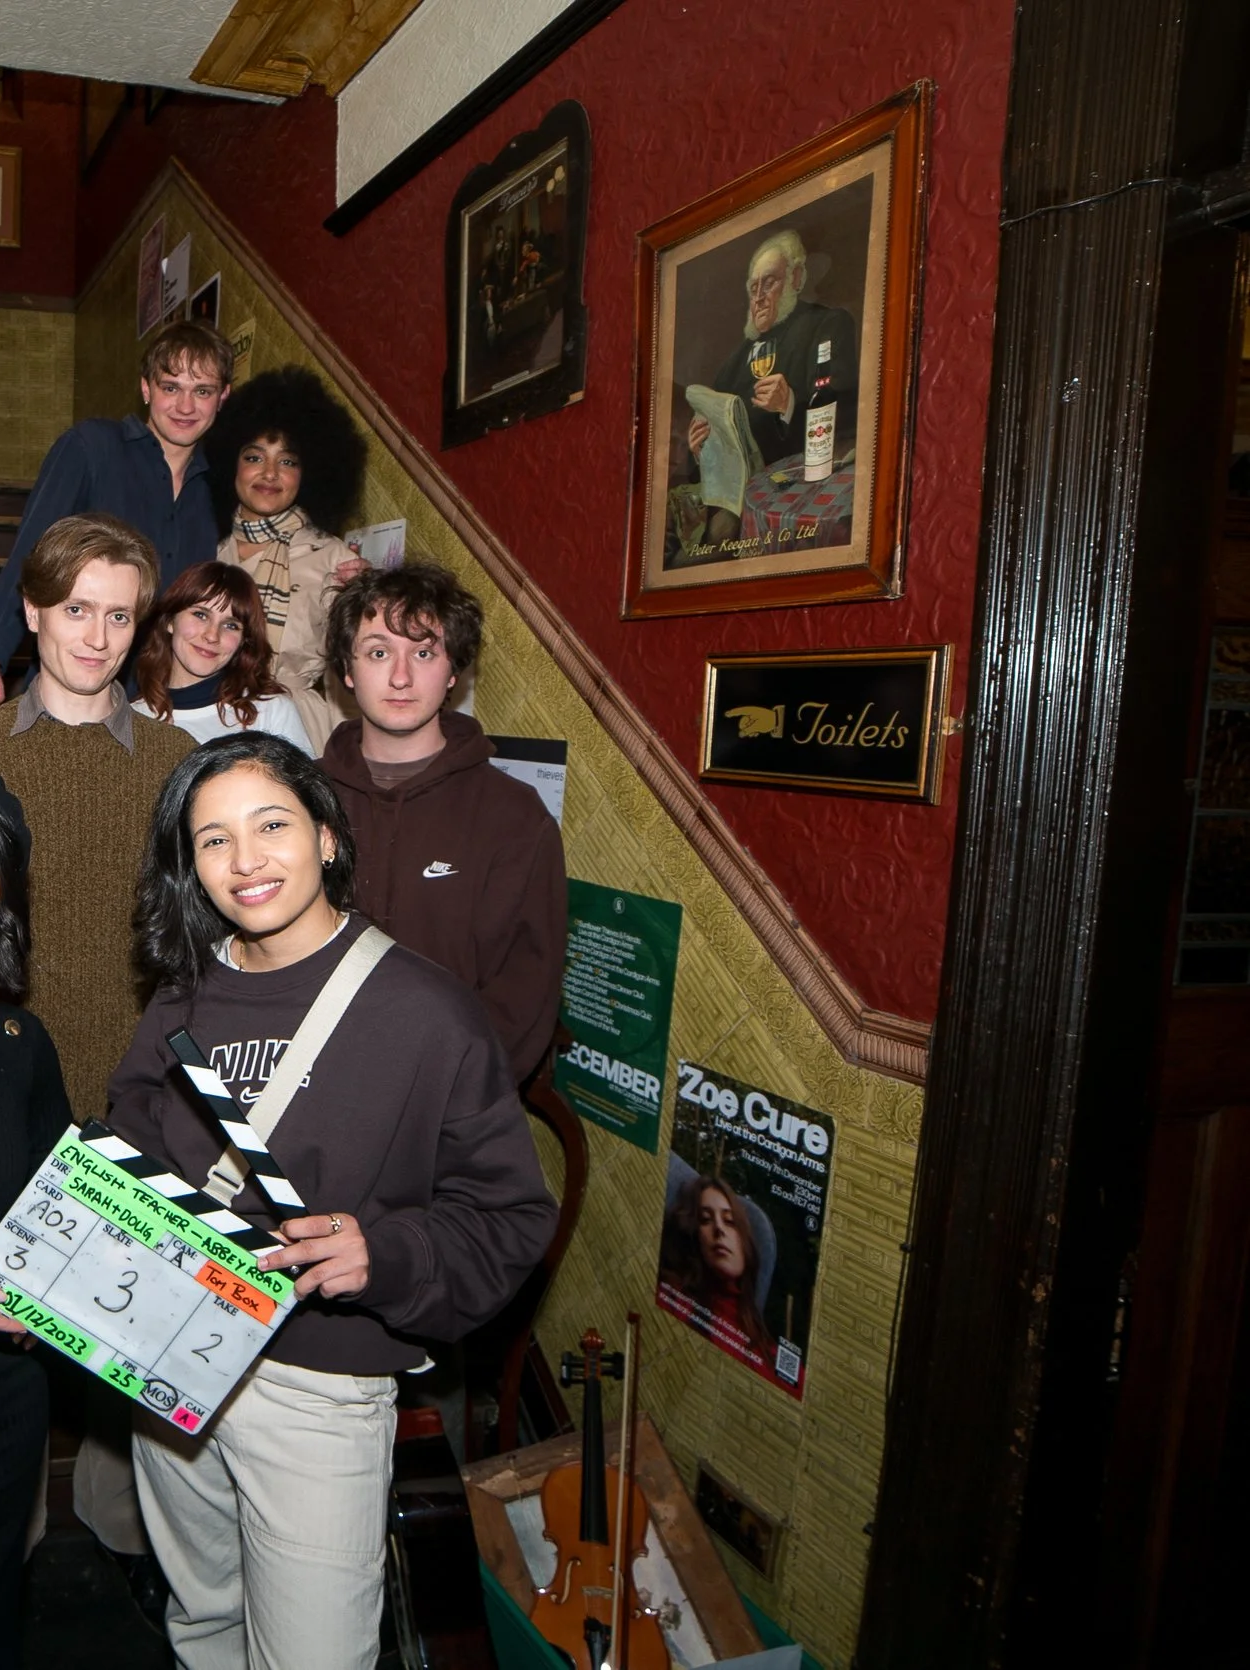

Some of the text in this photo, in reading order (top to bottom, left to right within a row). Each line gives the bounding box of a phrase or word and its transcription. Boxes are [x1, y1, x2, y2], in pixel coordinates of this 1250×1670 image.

[688, 544, 717, 557] Peter
[719, 537, 759, 557] Keegan
[763, 530, 774, 544] &
[792, 701, 909, 749] Toilets
[559, 1041, 660, 1104] ECEMBER
[679, 1065, 739, 1118] Zoe
[744, 1092, 829, 1156] Cure
[715, 1116, 826, 1173] Live at the Cardigan Arms
[51, 1158, 71, 1176] DIR:
[35, 1180, 63, 1201] CARD
[60, 1145, 126, 1190] ENGLISH
[132, 1188, 190, 1233] TEACHER
[201, 1237, 246, 1271] ABBEY
[245, 1266, 283, 1293] ROAD
[4, 1221, 37, 1245] SCENE
[102, 1223, 133, 1248] SLATE
[5, 1245, 30, 1271] 3
[170, 1250, 184, 1269] A
[213, 1296, 239, 1317] TAKE
[191, 1333, 223, 1364] 2
[108, 1368, 137, 1388] 25
[121, 1360, 138, 1374] FPS
[143, 1384, 175, 1408] MOS
[178, 1412, 189, 1424] A
[185, 1402, 206, 1418] CAM
